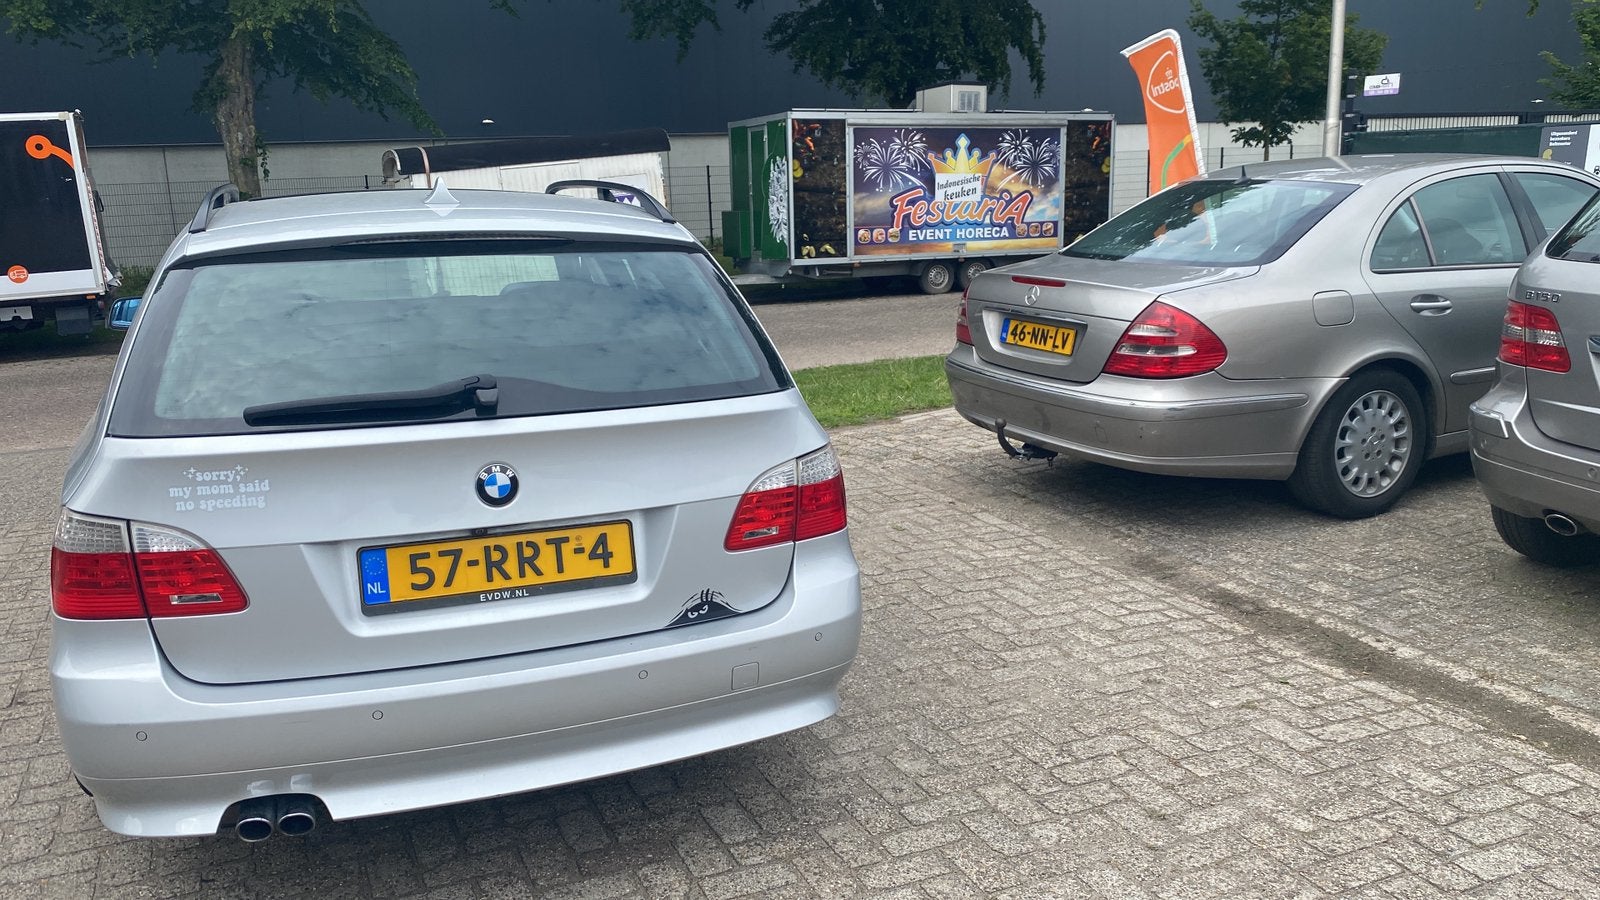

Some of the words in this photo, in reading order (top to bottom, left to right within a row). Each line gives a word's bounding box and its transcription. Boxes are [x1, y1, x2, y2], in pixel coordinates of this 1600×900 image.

[936, 175, 981, 191] Indonesische
[943, 187, 977, 201] keuken
[908, 229, 952, 241] EVENT
[956, 226, 1009, 239] HORECA
[1010, 323, 1071, 350] 46-NN-LV
[195, 469, 241, 482] sorry,
[479, 464, 515, 480] BMW
[169, 486, 192, 499] my
[196, 483, 234, 496] mom
[239, 479, 270, 493] said
[175, 500, 195, 511] no
[199, 494, 266, 512] speeding
[367, 582, 386, 595] NL
[408, 532, 614, 592] 57-RRT-4
[479, 588, 530, 602] EVDW.NL
